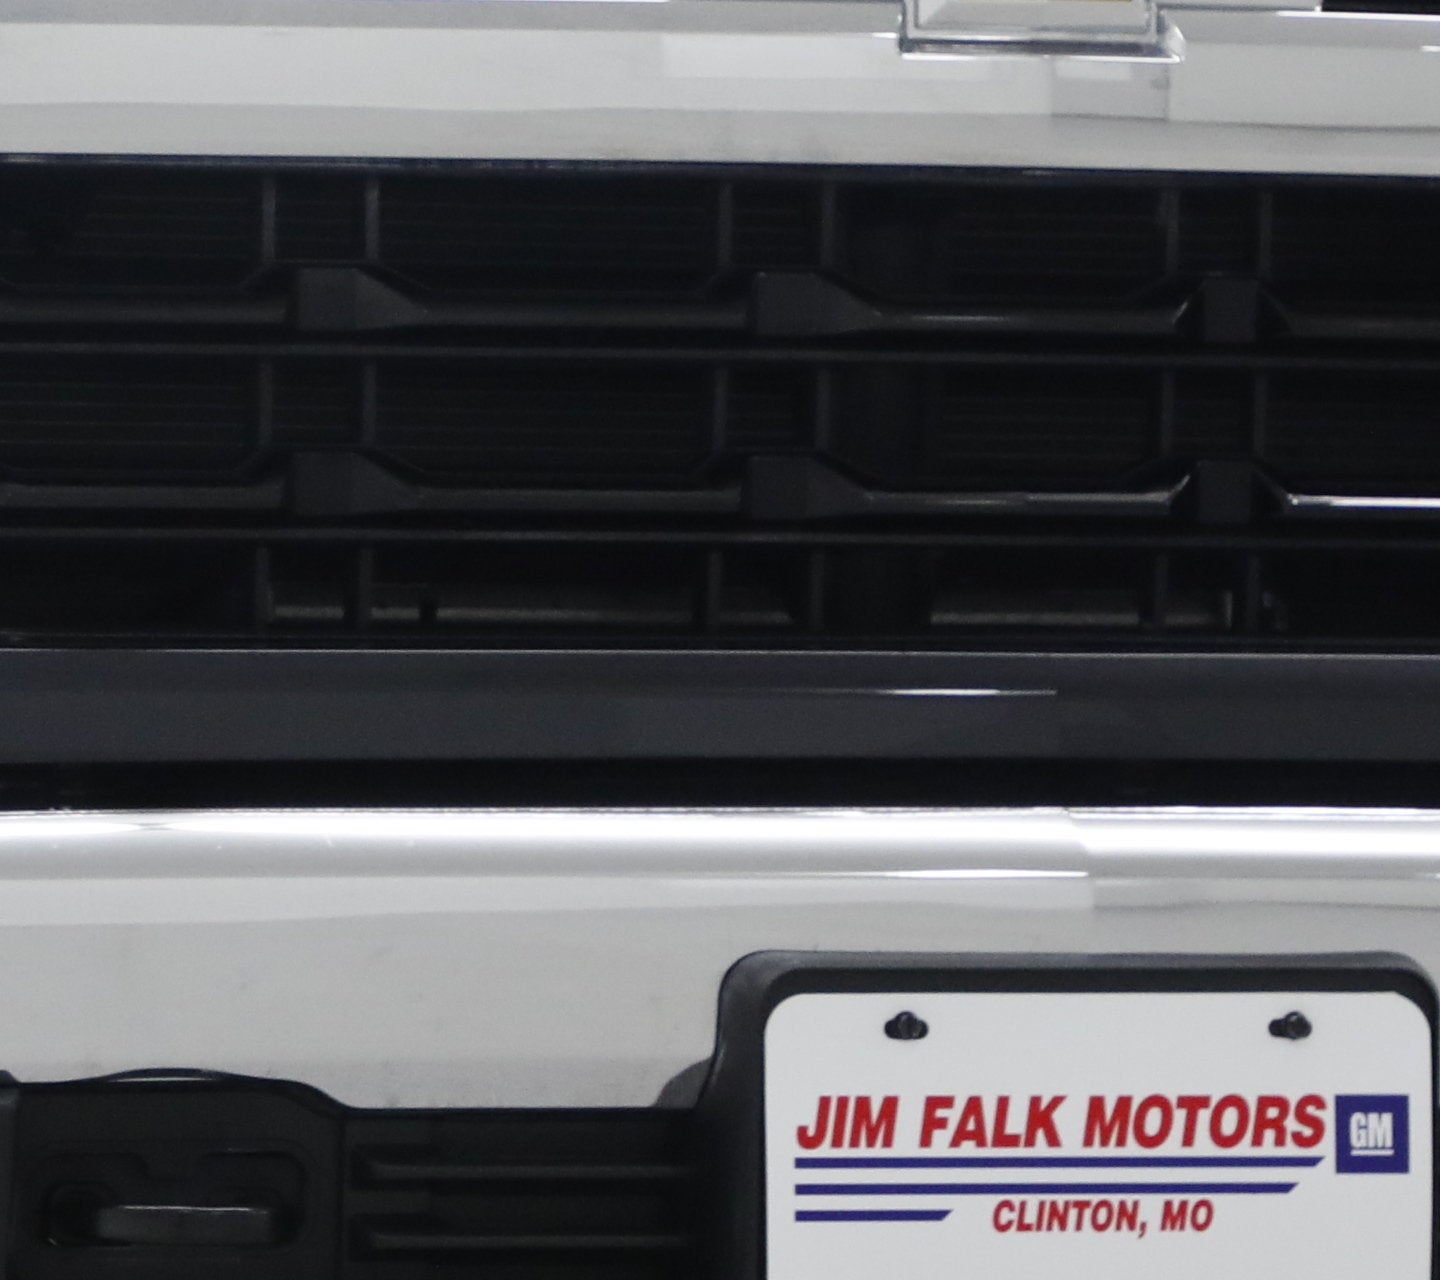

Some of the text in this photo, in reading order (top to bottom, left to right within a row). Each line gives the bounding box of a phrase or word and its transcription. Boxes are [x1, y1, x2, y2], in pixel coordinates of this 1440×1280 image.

[795, 1093, 1328, 1151] JIM FALK MOTORS
[1349, 1111, 1394, 1148] GM
[991, 1198, 1215, 1239] CLINTON, MO
